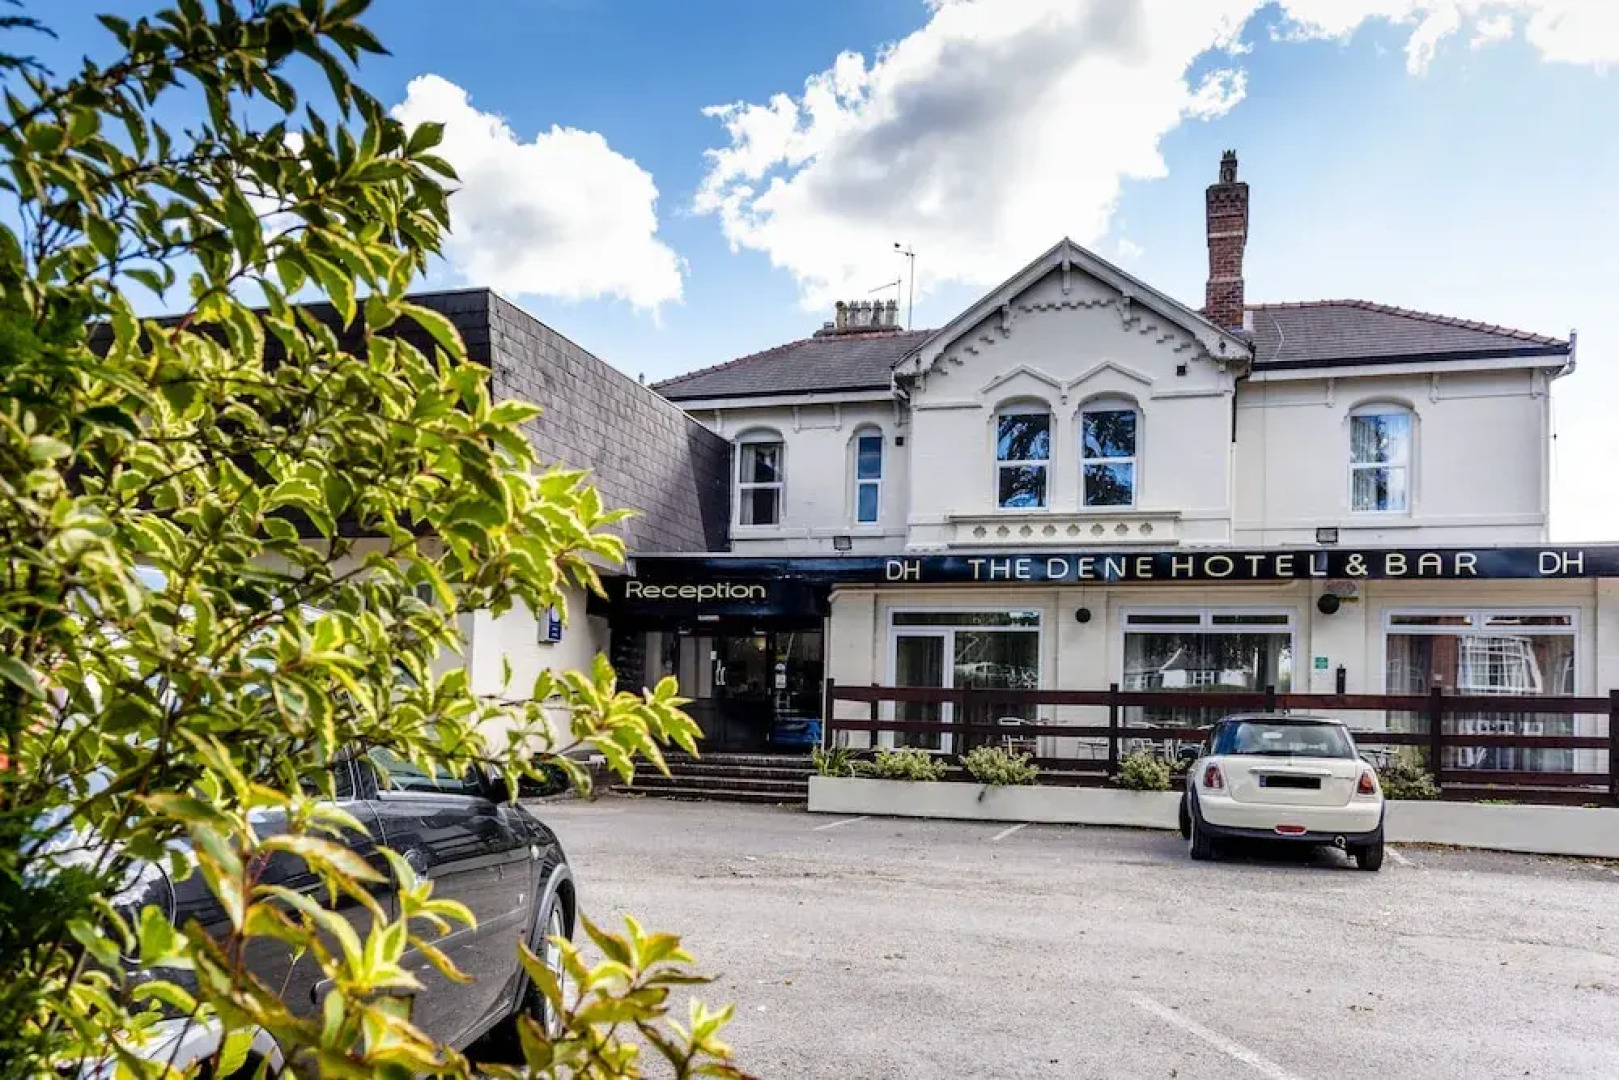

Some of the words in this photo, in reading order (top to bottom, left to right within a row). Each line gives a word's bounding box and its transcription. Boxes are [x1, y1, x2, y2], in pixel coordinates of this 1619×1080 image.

[886, 560, 920, 580] DH
[967, 558, 1031, 579] THE
[1047, 557, 1153, 578] DENE
[1171, 554, 1327, 577] HOTEL
[1345, 553, 1369, 576] &
[1385, 553, 1477, 576] BAR
[1539, 552, 1584, 575] DH
[625, 580, 767, 602] Reception
